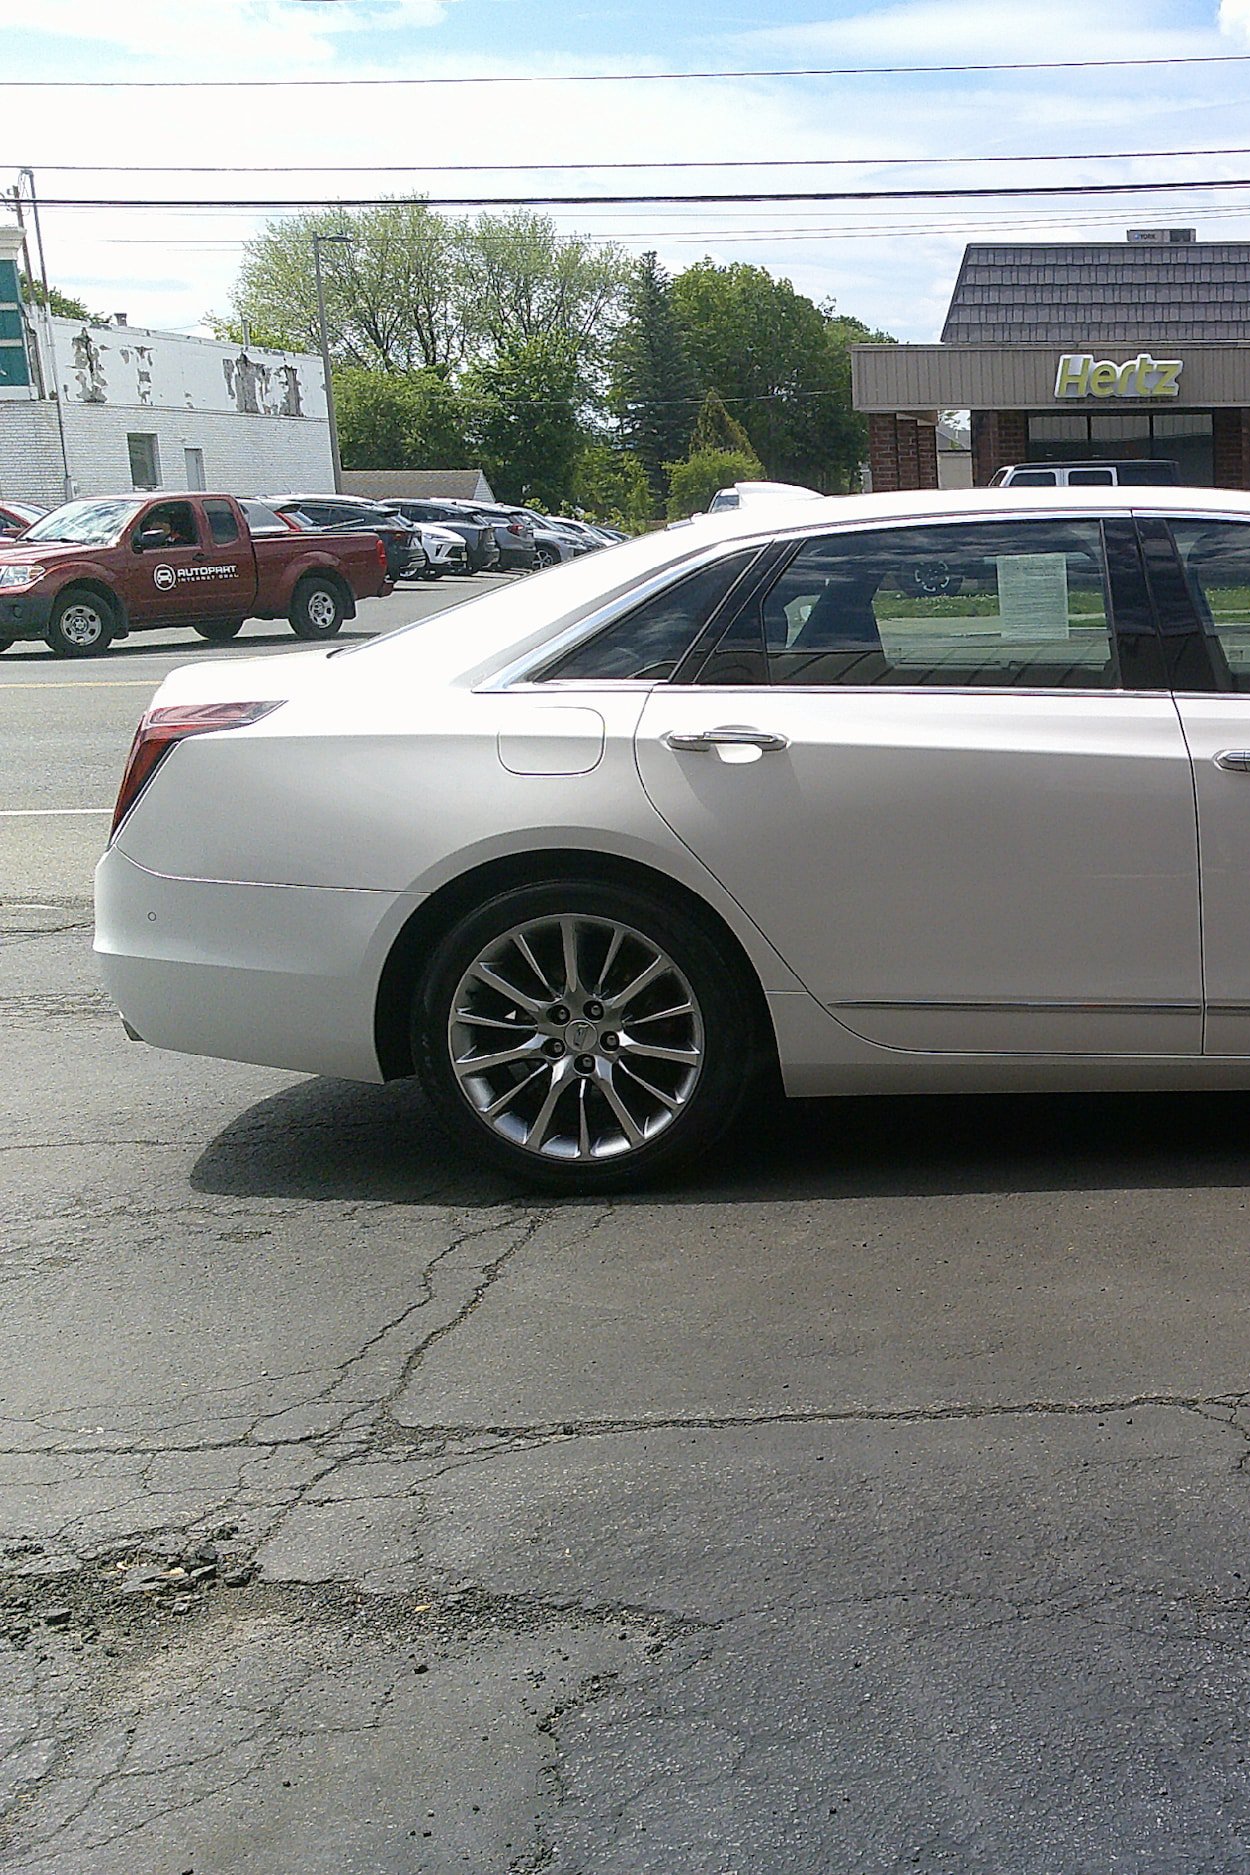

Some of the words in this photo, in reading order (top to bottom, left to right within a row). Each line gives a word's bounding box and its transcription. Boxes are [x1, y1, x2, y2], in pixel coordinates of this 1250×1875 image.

[1056, 355, 1182, 398] Hertz
[177, 565, 237, 578] AUTOPART
[177, 573, 239, 583] INTERNATONAL
